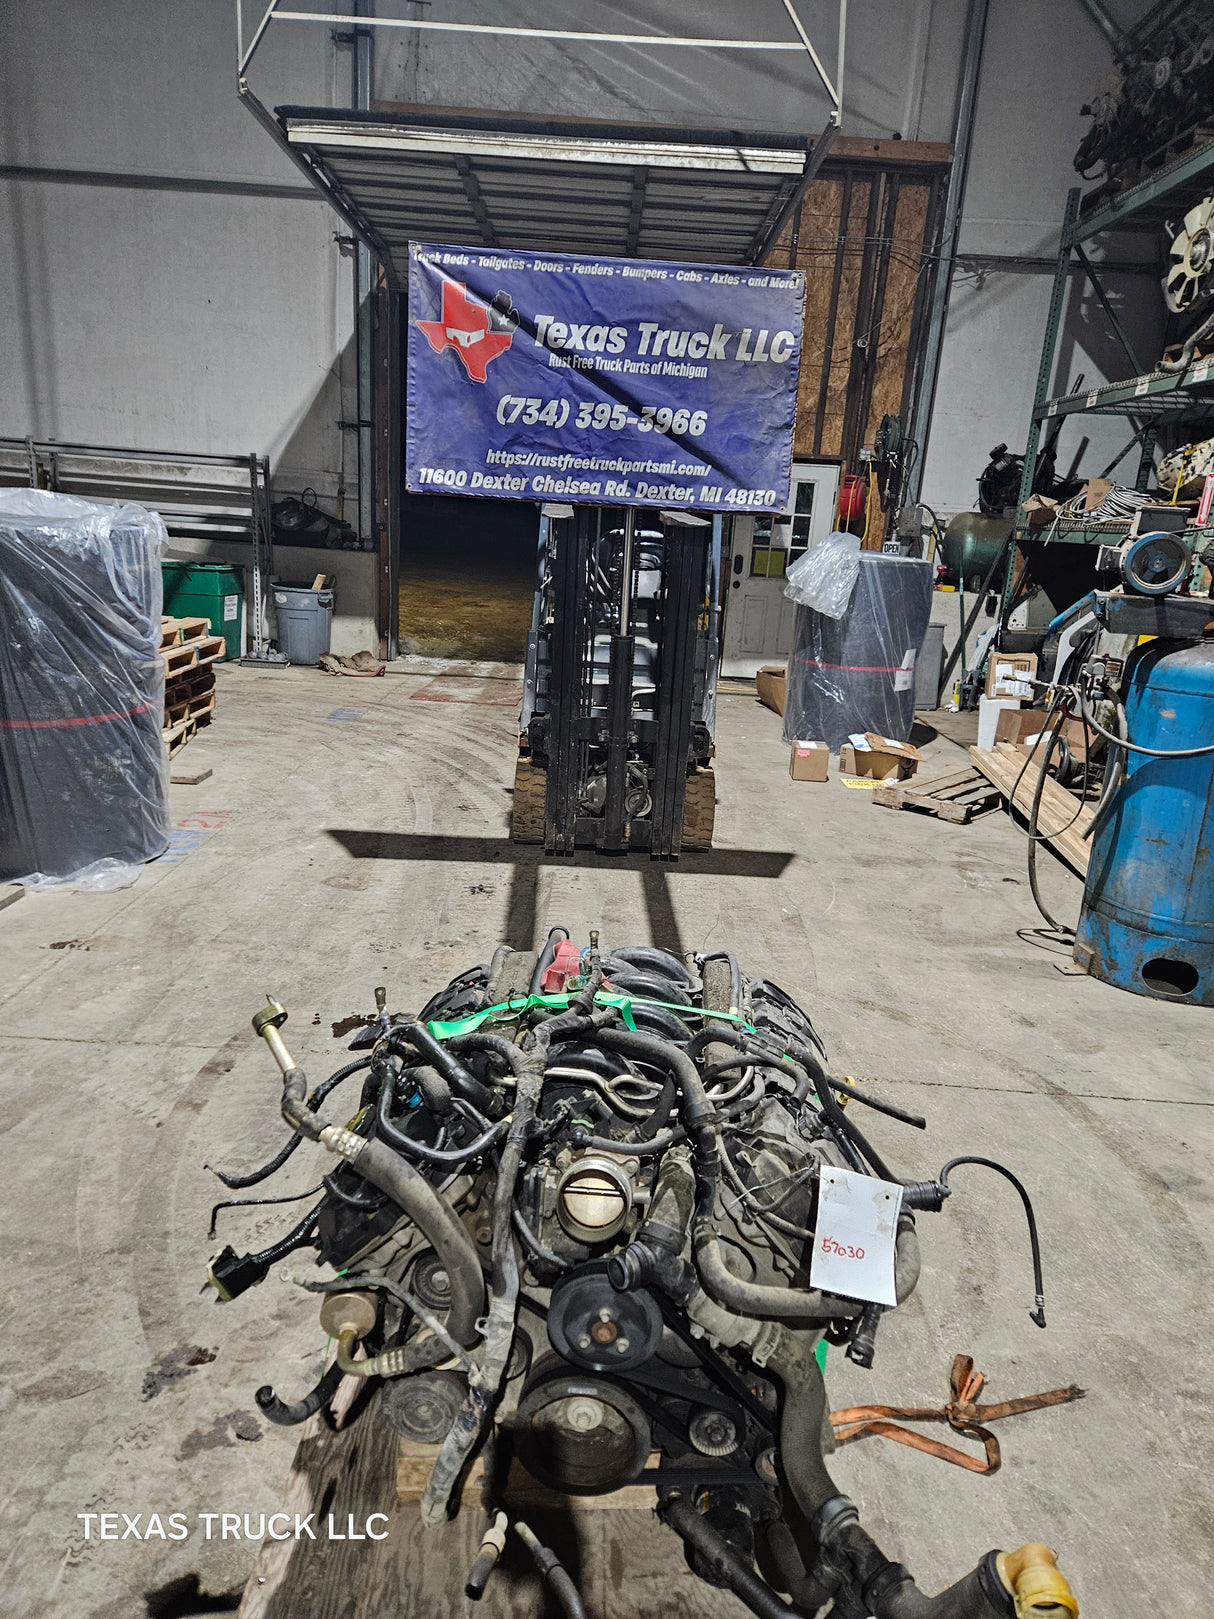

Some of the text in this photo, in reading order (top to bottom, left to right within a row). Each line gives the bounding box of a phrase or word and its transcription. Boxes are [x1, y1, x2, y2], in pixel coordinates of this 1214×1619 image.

[443, 253, 469, 265] Beds
[478, 257, 525, 271] Tailgates
[533, 260, 564, 273] Doors
[572, 263, 614, 276] Fenders
[622, 266, 668, 280] Bumpers
[676, 270, 702, 283] Cabs
[710, 272, 740, 286] Axles
[748, 276, 768, 288] and
[534, 314, 795, 364] Texas Truck LLC
[549, 353, 708, 379] Rust Free Truck Parts of Michigan
[496, 394, 708, 436] (734) 395-3966
[486, 449, 712, 476] https://rustfreetruckpartsmi.com/
[419, 467, 777, 506] 11600 Dexter Chelsea Rd. Dexter, MI 48130
[884, 543, 899, 553] OPEN
[821, 1236, 865, 1260] 57030
